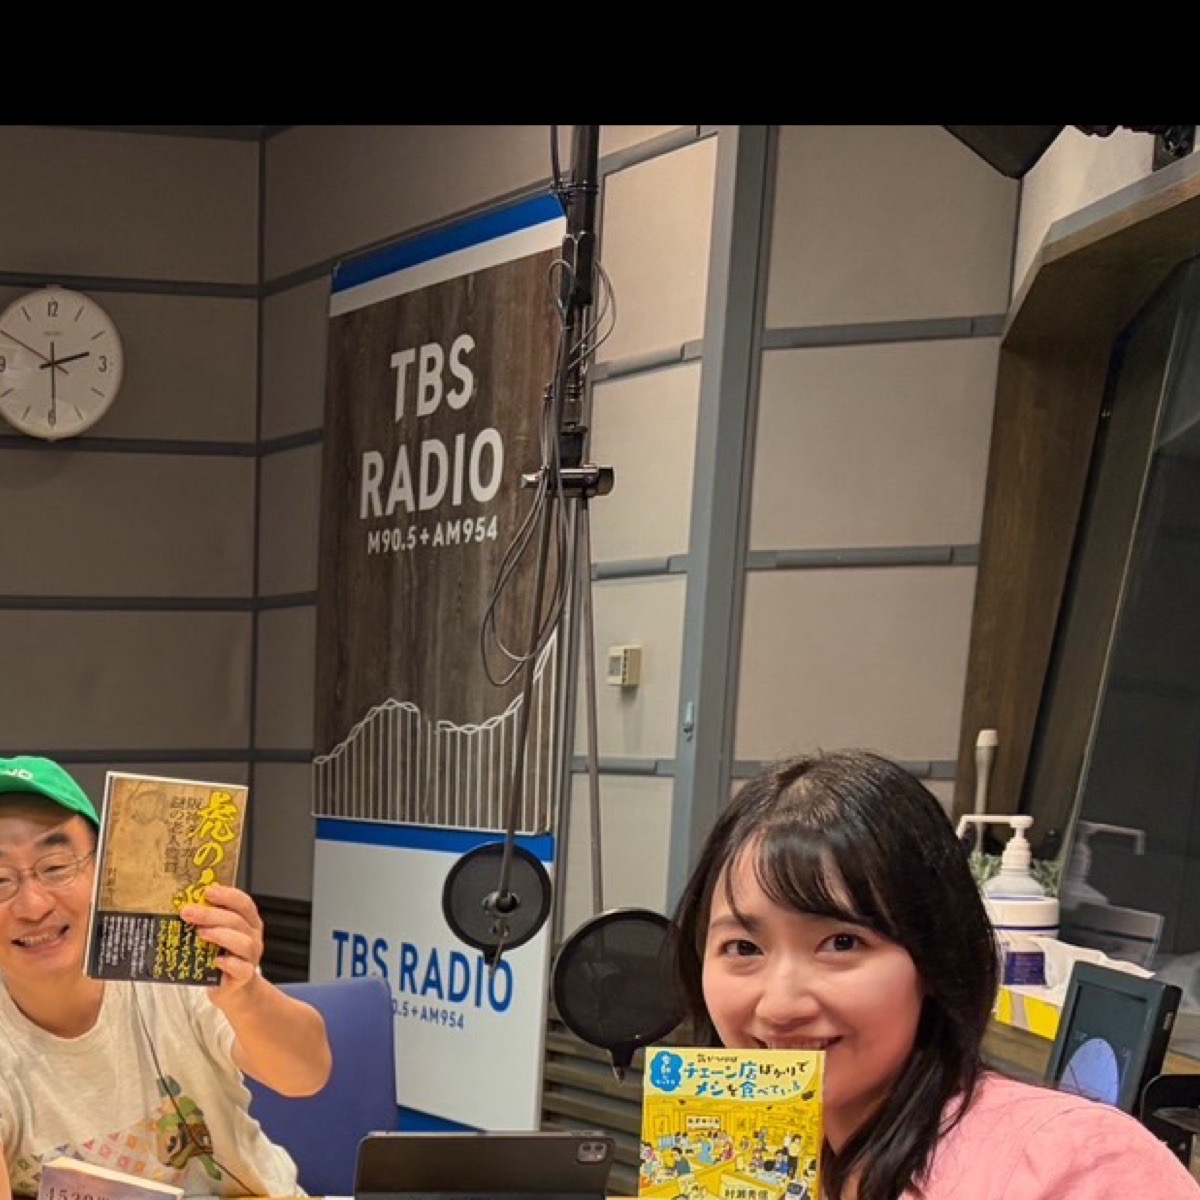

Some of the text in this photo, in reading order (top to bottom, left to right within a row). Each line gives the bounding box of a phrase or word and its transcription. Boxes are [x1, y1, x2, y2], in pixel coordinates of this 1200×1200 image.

[47, 301, 59, 318] 12
[98, 355, 108, 373] 3
[391, 333, 476, 422] TBS
[360, 427, 504, 520] RADIO
[332, 930, 514, 1013] TBS RADIO
